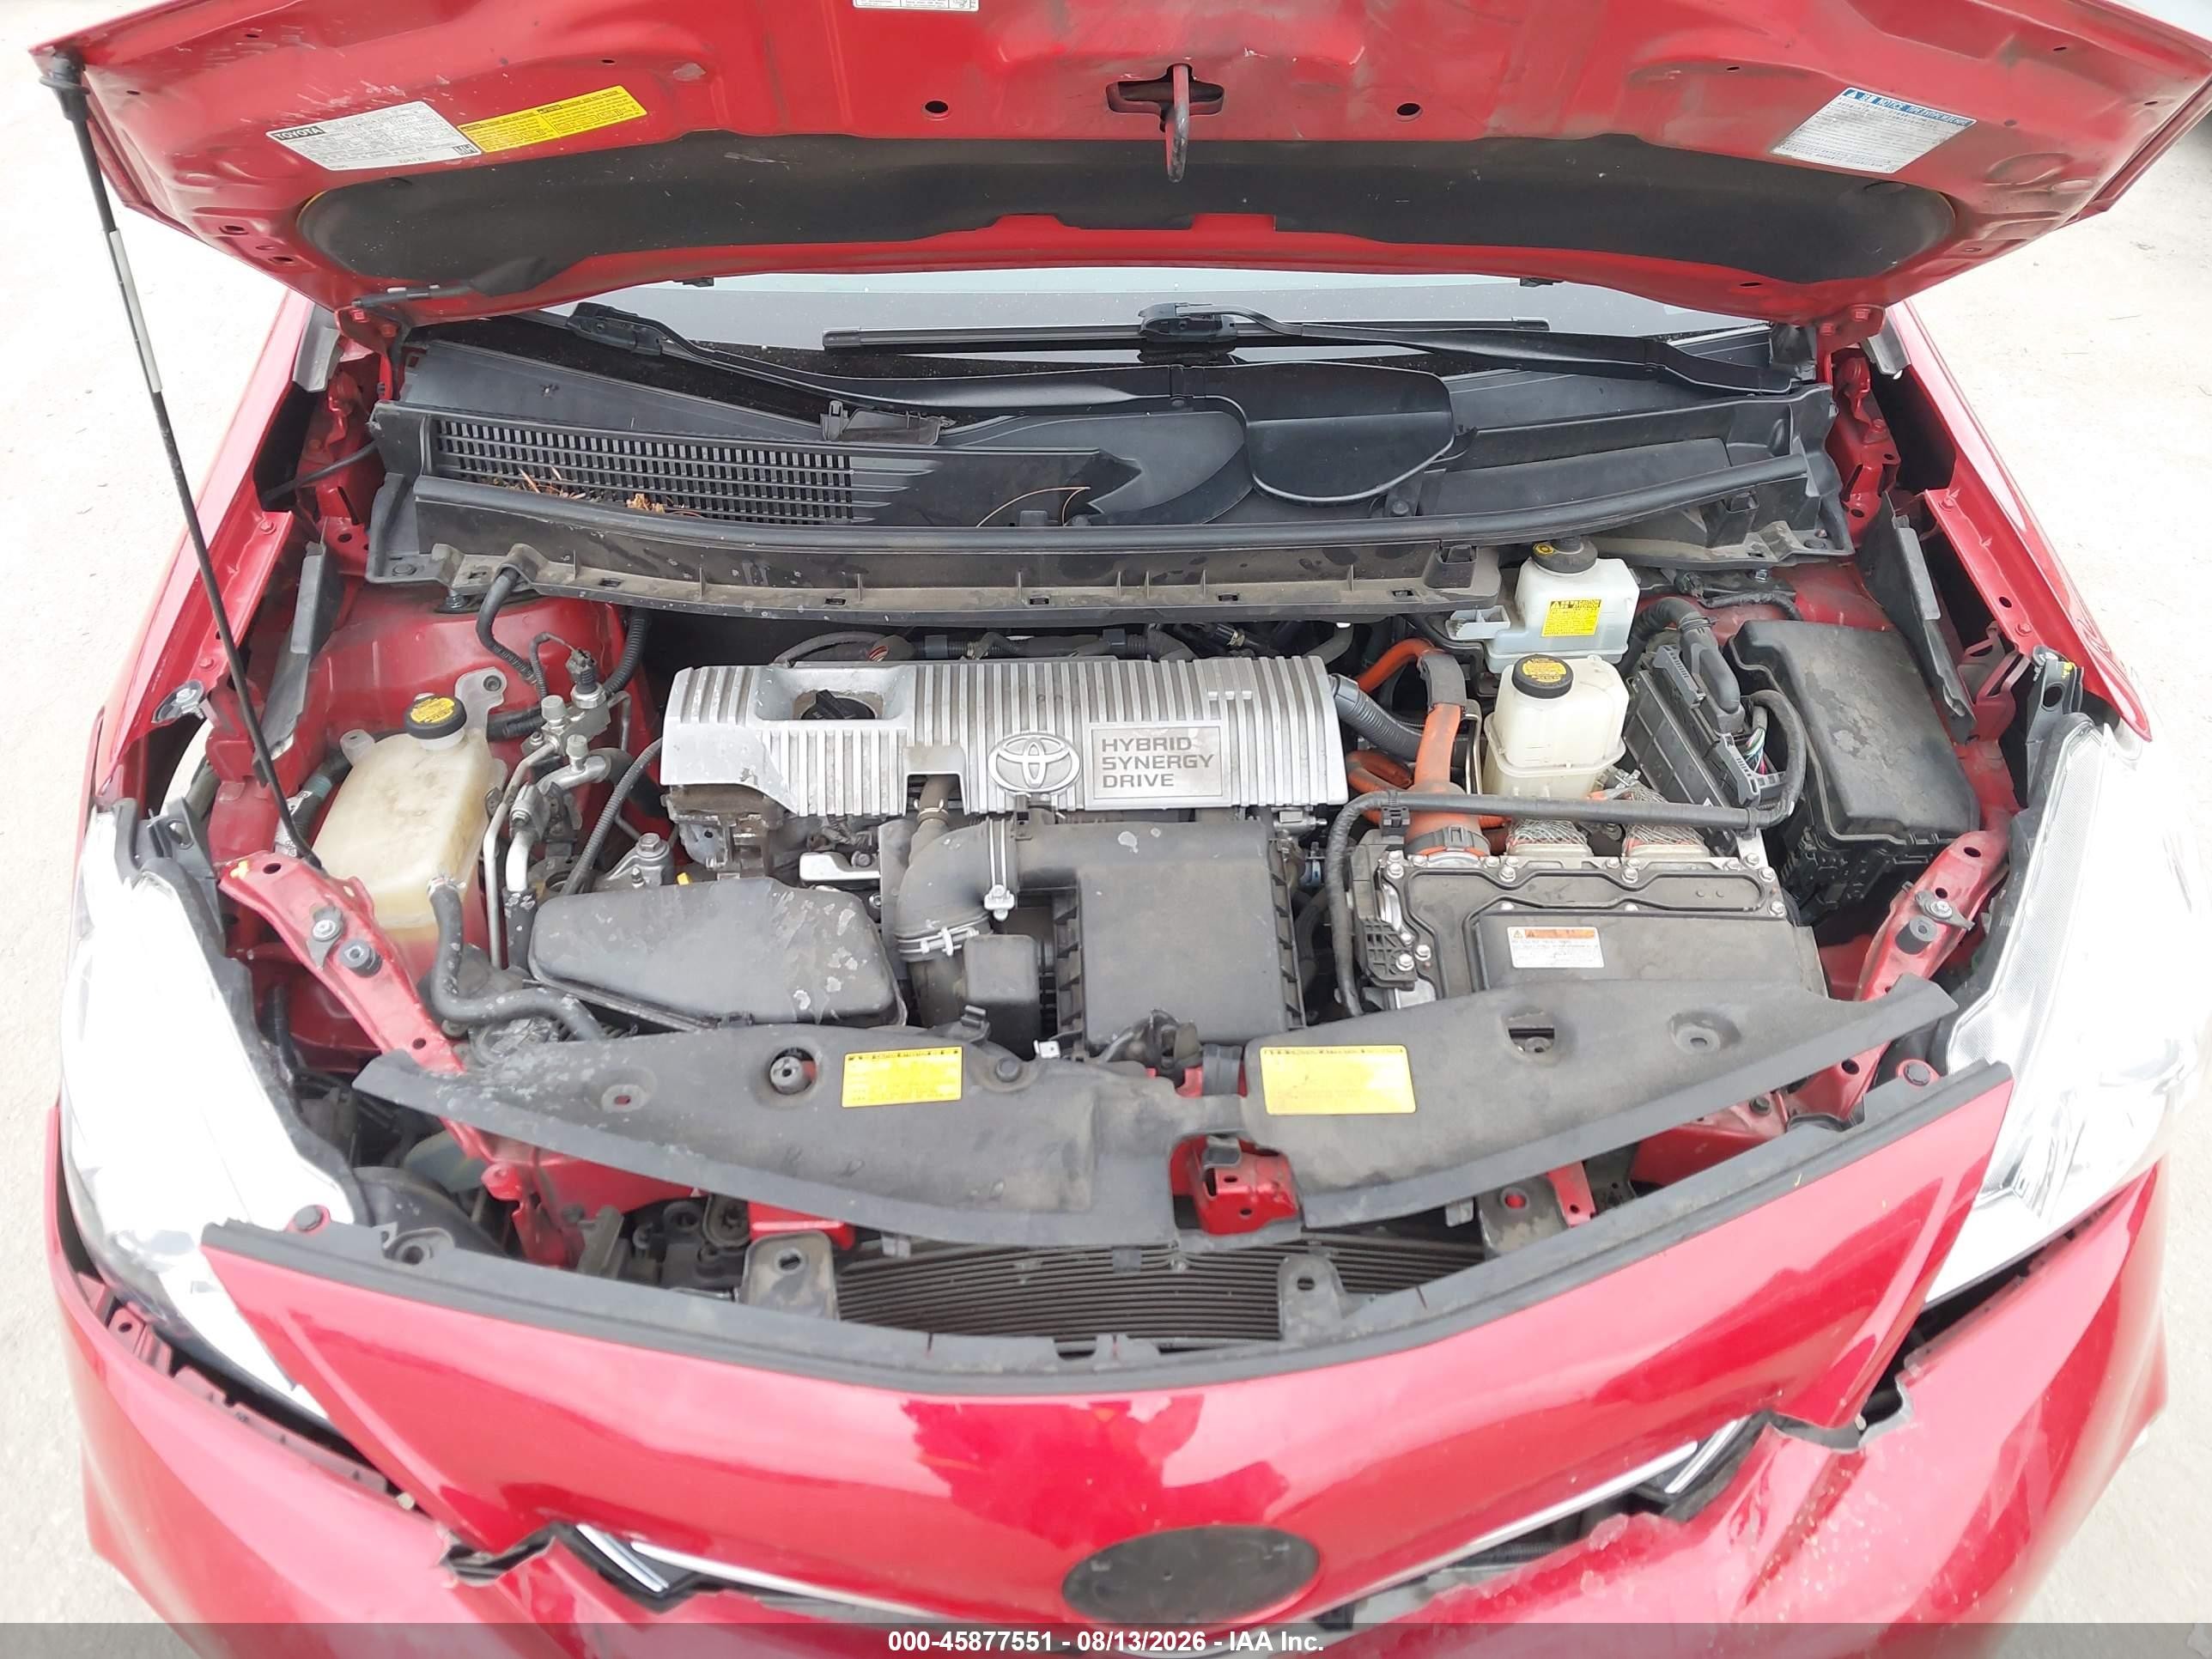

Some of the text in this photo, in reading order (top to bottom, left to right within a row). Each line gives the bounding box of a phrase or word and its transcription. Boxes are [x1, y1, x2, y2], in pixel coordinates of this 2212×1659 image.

[1876, 99, 1906, 110] NOTICE
[274, 126, 324, 139] TOYOTA
[1102, 737, 1193, 751] HYBRID
[1102, 754, 1215, 769] SYNERGY
[1102, 774, 1175, 788] DRIVE
